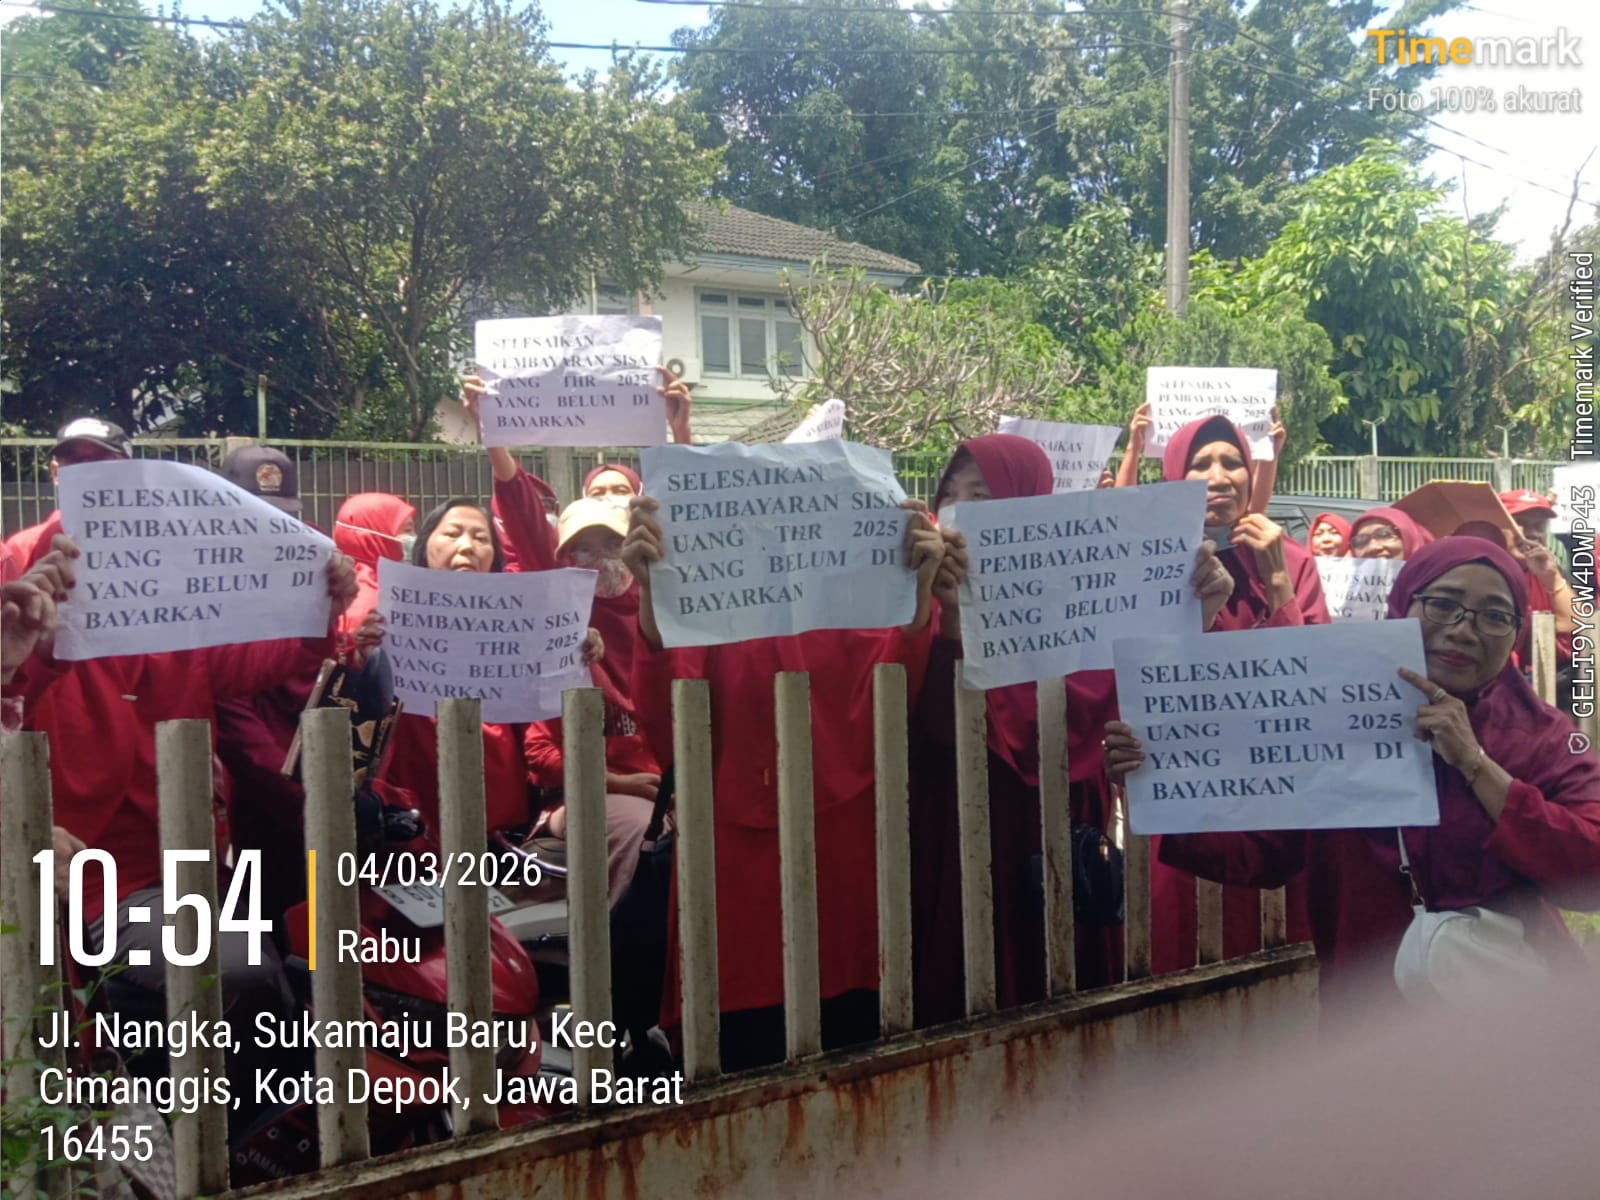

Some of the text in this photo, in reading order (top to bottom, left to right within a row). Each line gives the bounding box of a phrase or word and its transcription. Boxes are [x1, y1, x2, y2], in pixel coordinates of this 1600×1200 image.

[613, 354, 649, 367] SISA
[563, 375, 597, 388] THR
[617, 374, 649, 387] 2025
[495, 394, 649, 409] YANG BELUM DI
[497, 415, 586, 428] BAYARKAN
[667, 466, 825, 493] SELESAIKAN
[82, 488, 243, 509] SELESAIKAN
[669, 490, 900, 523] PEMBAYARAN SISA
[84, 517, 259, 539] PEMBAYARAN
[672, 519, 899, 553] UANG THR 2025
[979, 515, 1120, 548] SELESAIKAN
[86, 544, 318, 570] UANG THR 2025
[675, 548, 896, 584] YANG BELUM DI
[979, 537, 1188, 575] PEMBAYARAN SISA
[86, 571, 314, 600] YANG BELUM DI
[979, 563, 1185, 602] UANG THR 2025
[391, 585, 524, 610] SELESAIKAN
[679, 583, 804, 616] BAYARKAN
[980, 589, 1181, 630] YANG BELUM DI
[85, 603, 222, 630] BAYARKAN
[390, 610, 580, 633] PEMBAYARAN SISA
[390, 632, 578, 656] UANG THR 2025
[982, 626, 1097, 659] BAYARKAN
[391, 655, 446, 676] YANG
[469, 662, 542, 679] BELUM
[1140, 656, 1309, 684] SELESAIKAN
[394, 675, 503, 700] BAYARKAN
[1144, 682, 1402, 714] PEMBAYARAN SISA
[1147, 713, 1402, 742] UANG THR 2025
[1150, 741, 1404, 770] YANG BELUM DI
[1152, 775, 1295, 801] BAYARKAN
